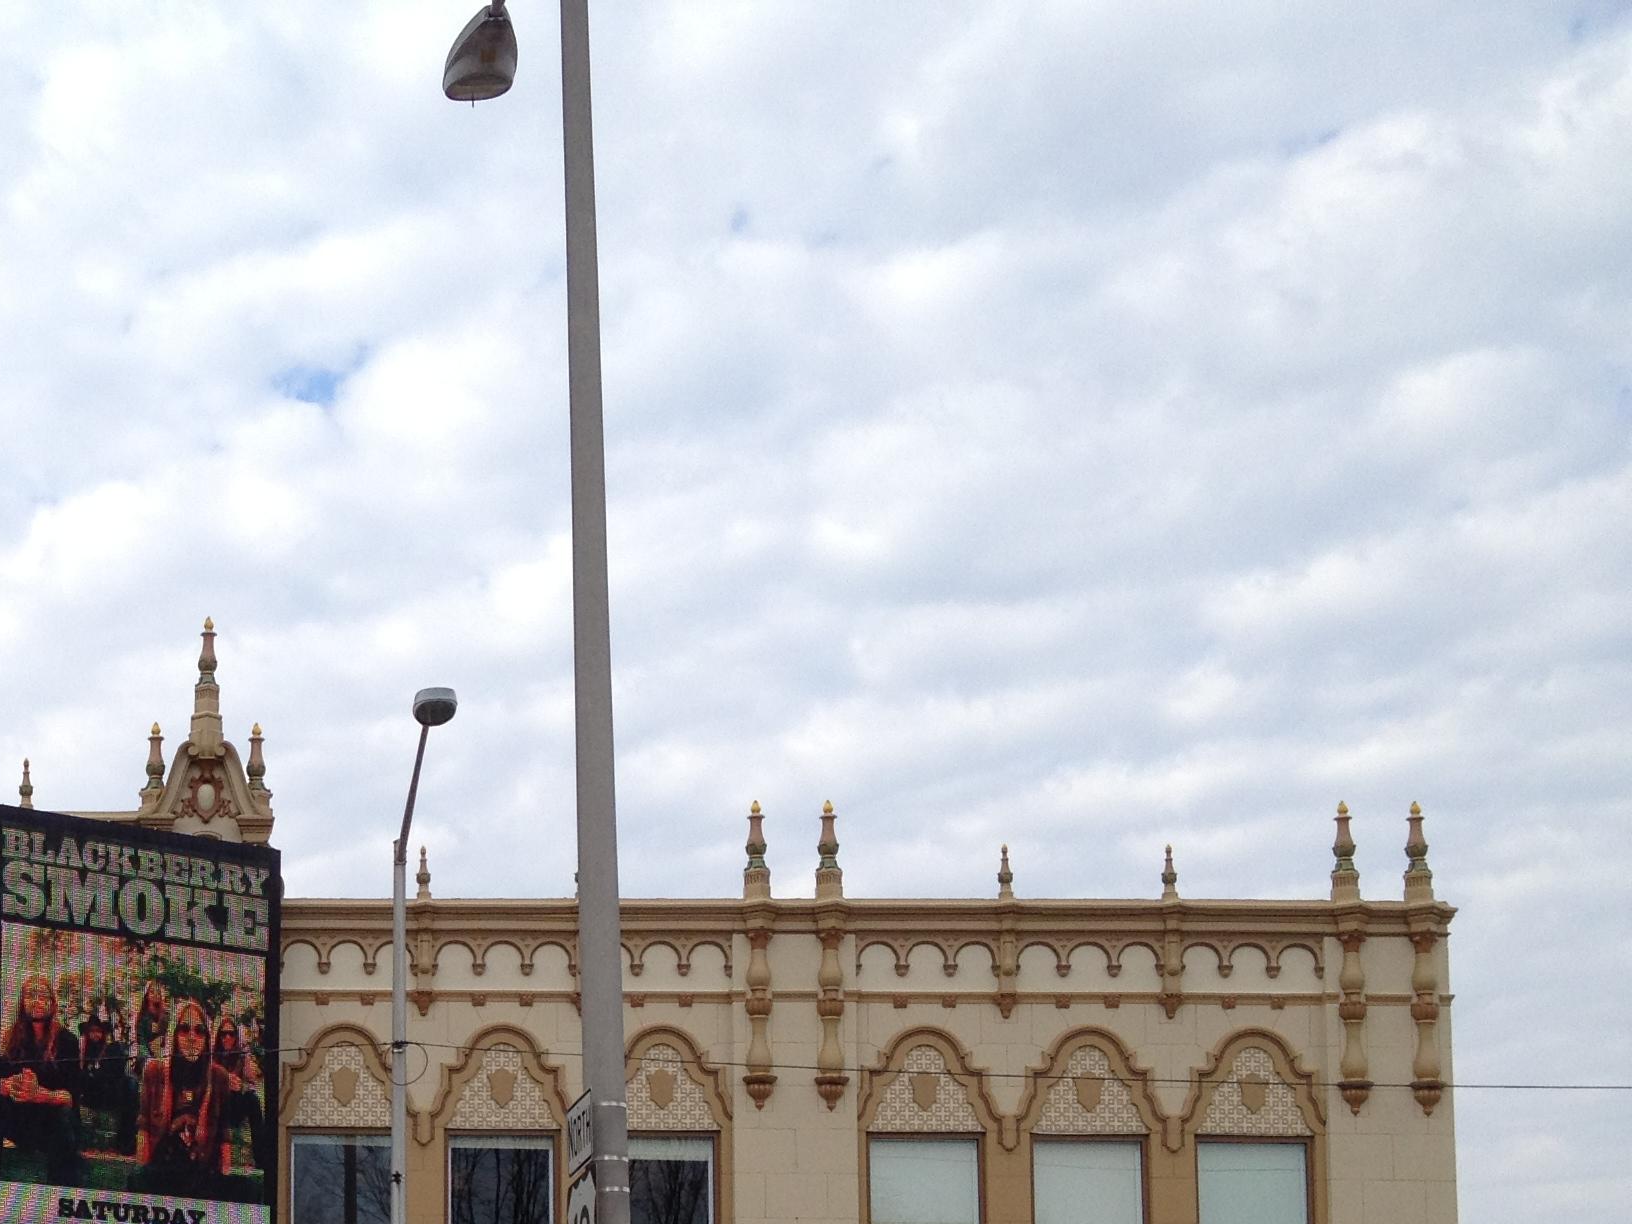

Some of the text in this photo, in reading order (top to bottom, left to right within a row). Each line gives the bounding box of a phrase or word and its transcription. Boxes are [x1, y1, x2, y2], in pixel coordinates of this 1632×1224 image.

[2, 827, 269, 896] BLACKBERRY
[2, 860, 269, 951] SMOKE
[568, 1108, 591, 1159] NORTH
